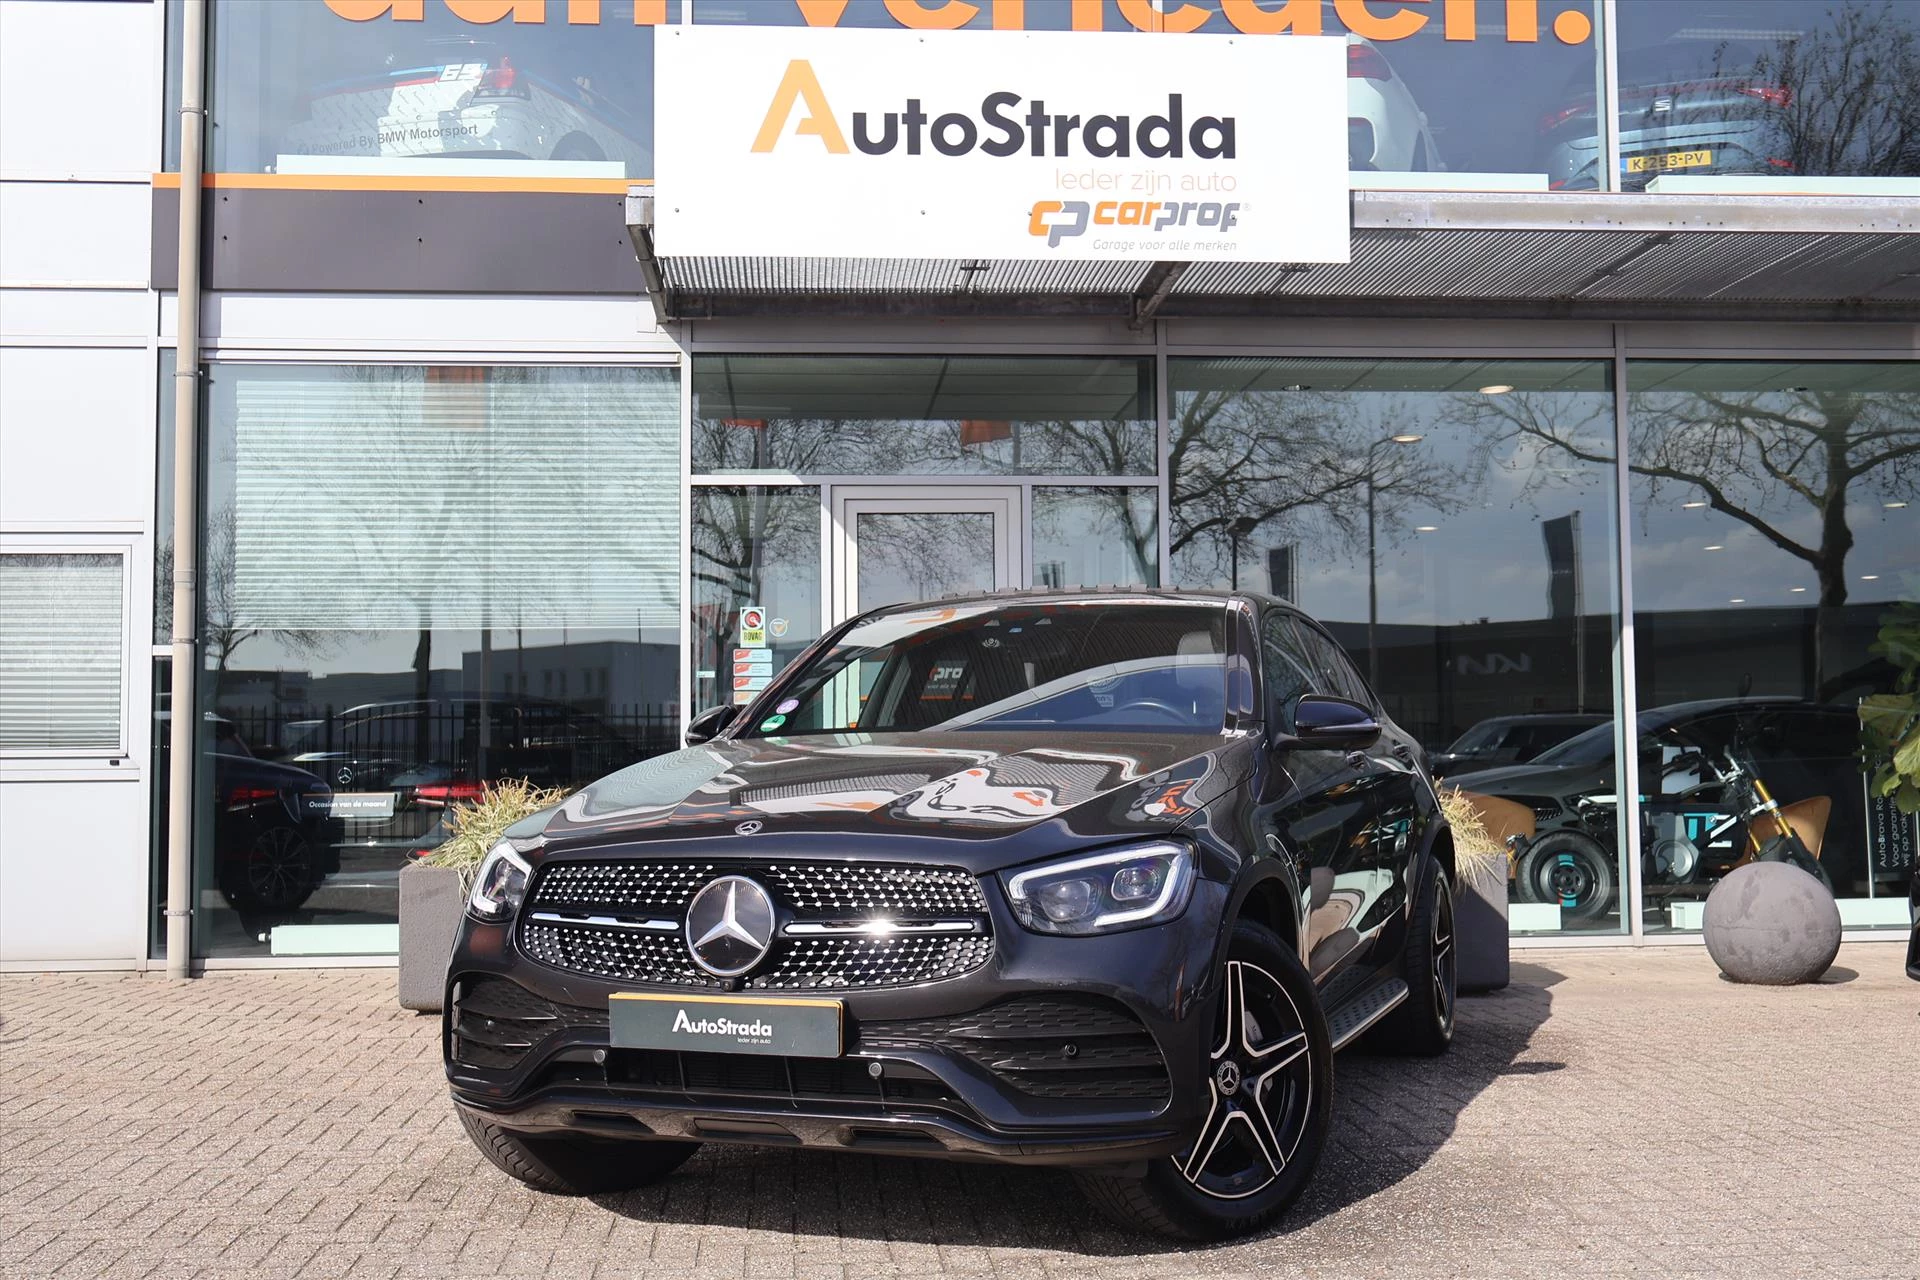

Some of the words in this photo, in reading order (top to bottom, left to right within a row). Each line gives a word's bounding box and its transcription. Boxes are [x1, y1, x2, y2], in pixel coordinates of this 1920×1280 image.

[750, 59, 1236, 160] AutoStrada
[312, 134, 356, 153] Powered
[359, 135, 374, 149] By
[377, 130, 406, 145] BMW
[410, 124, 478, 140] Motorsport
[1632, 152, 1704, 170] K-253-PV
[1055, 168, 1122, 191] Ieder
[1131, 170, 1171, 196] zijn
[1180, 171, 1237, 192] auto
[1093, 239, 1135, 253] Garage
[1138, 241, 1165, 251] voor
[1168, 239, 1190, 251] alle
[1193, 240, 1237, 252] merken
[743, 631, 763, 641] BOVAG
[308, 800, 338, 808] Occasion
[353, 800, 362, 808] de
[362, 800, 387, 808] maand
[1877, 813, 1887, 868] AutoBrava
[1890, 846, 1900, 868] Voor
[672, 1009, 772, 1037] AutoStrada
